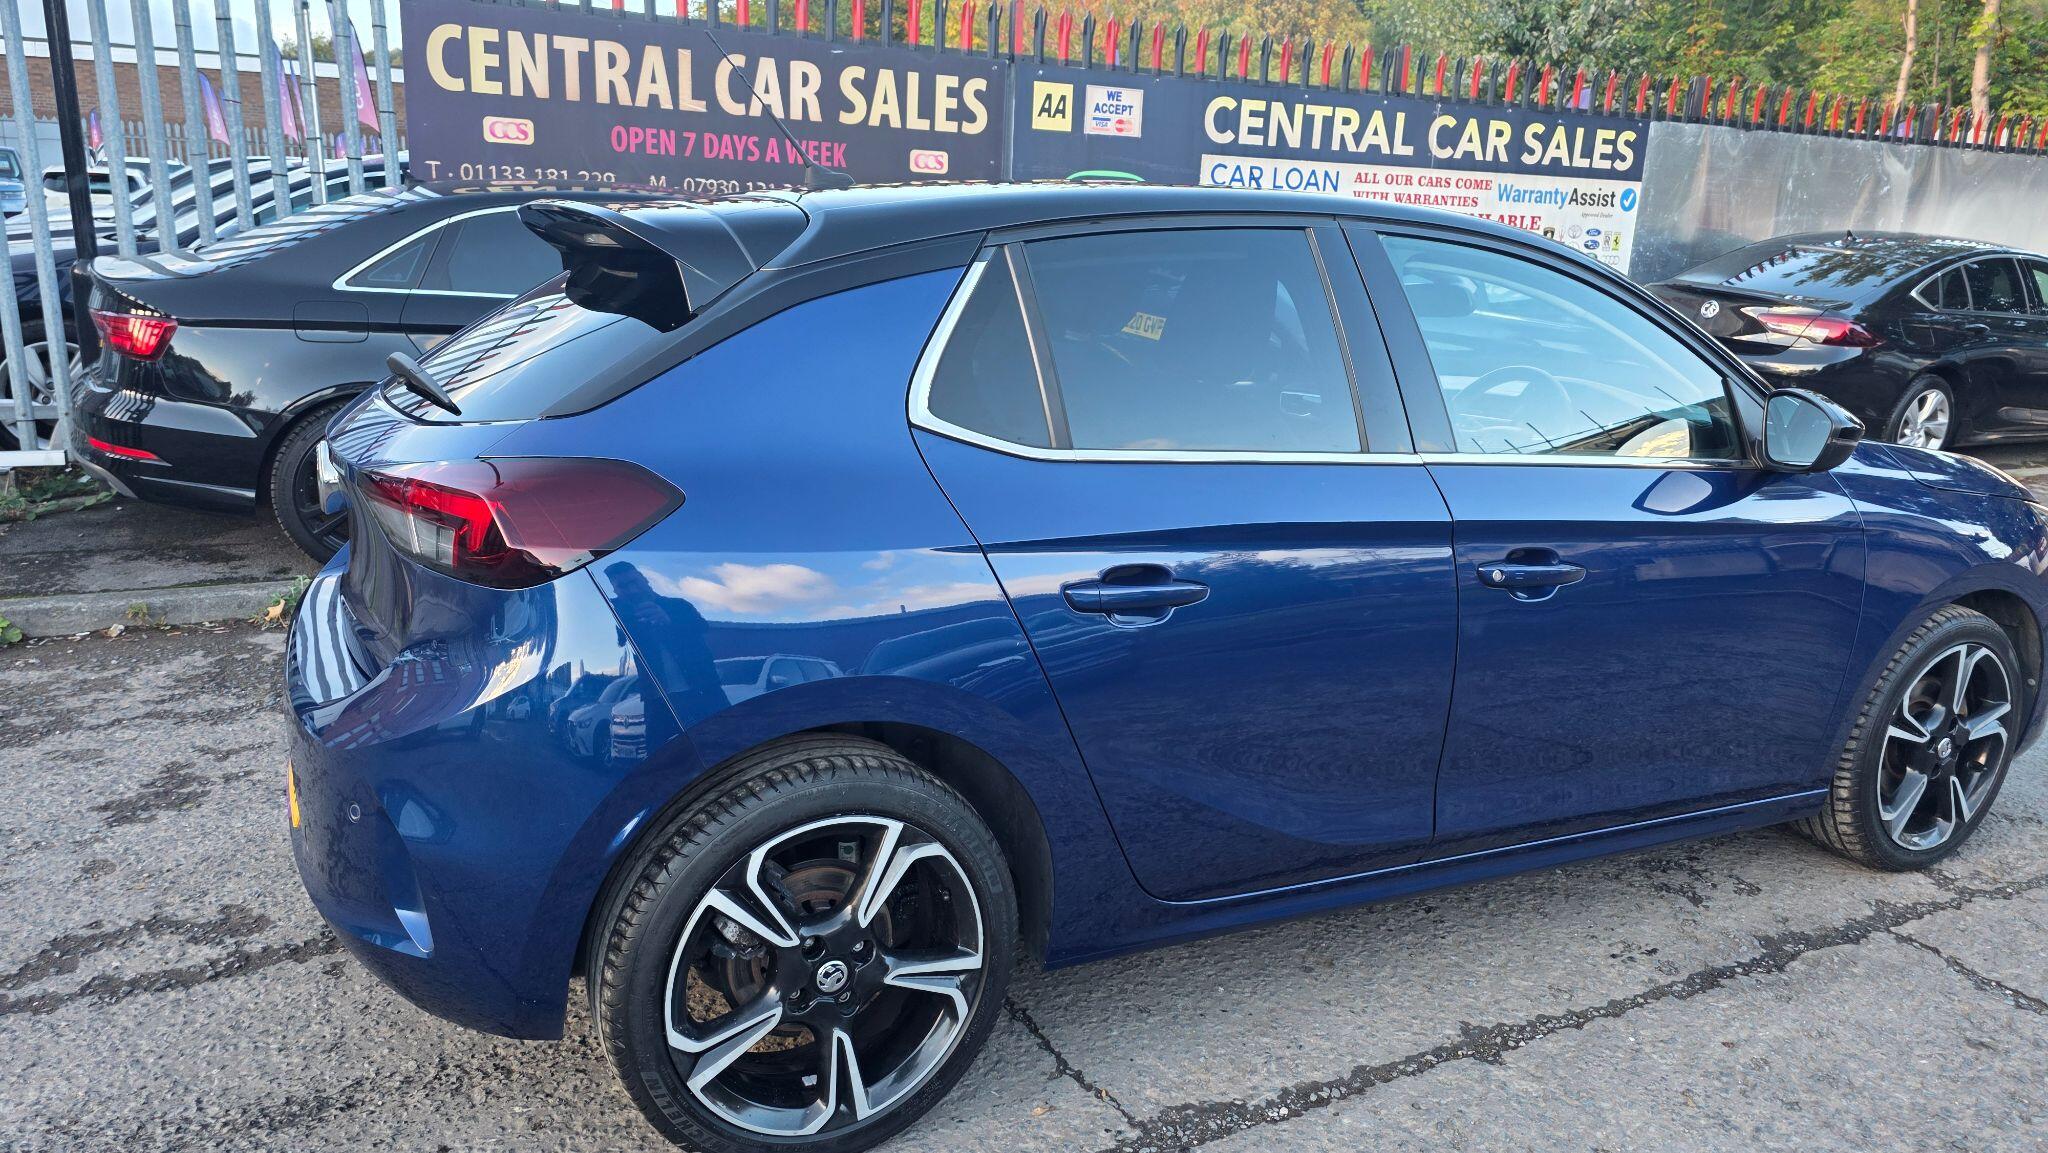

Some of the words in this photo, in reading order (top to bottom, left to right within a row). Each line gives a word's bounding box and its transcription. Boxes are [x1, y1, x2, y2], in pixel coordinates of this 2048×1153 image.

[426, 23, 707, 112] CENTRAL
[715, 53, 822, 122] CAR
[838, 65, 988, 135] SALES
[1038, 93, 1067, 119] AA
[1094, 102, 1133, 116] ACCEPT
[1107, 90, 1122, 102] WE
[611, 125, 676, 156] OPEN
[683, 131, 697, 157] 7
[704, 132, 760, 162] DAYS
[765, 137, 781, 164] A
[785, 140, 847, 168] WEEK
[1204, 96, 1414, 156] CENTRAL
[1428, 115, 1512, 163] CAR
[1520, 122, 1637, 172] SALES
[1210, 163, 1262, 190] CAR
[1272, 167, 1340, 192] LOAN
[1354, 172, 1380, 184] ALL
[1385, 173, 1413, 186] OUR
[1418, 175, 1452, 188] CARS
[1455, 178, 1493, 191] COME
[1394, 192, 1479, 208] WARRANTIES
